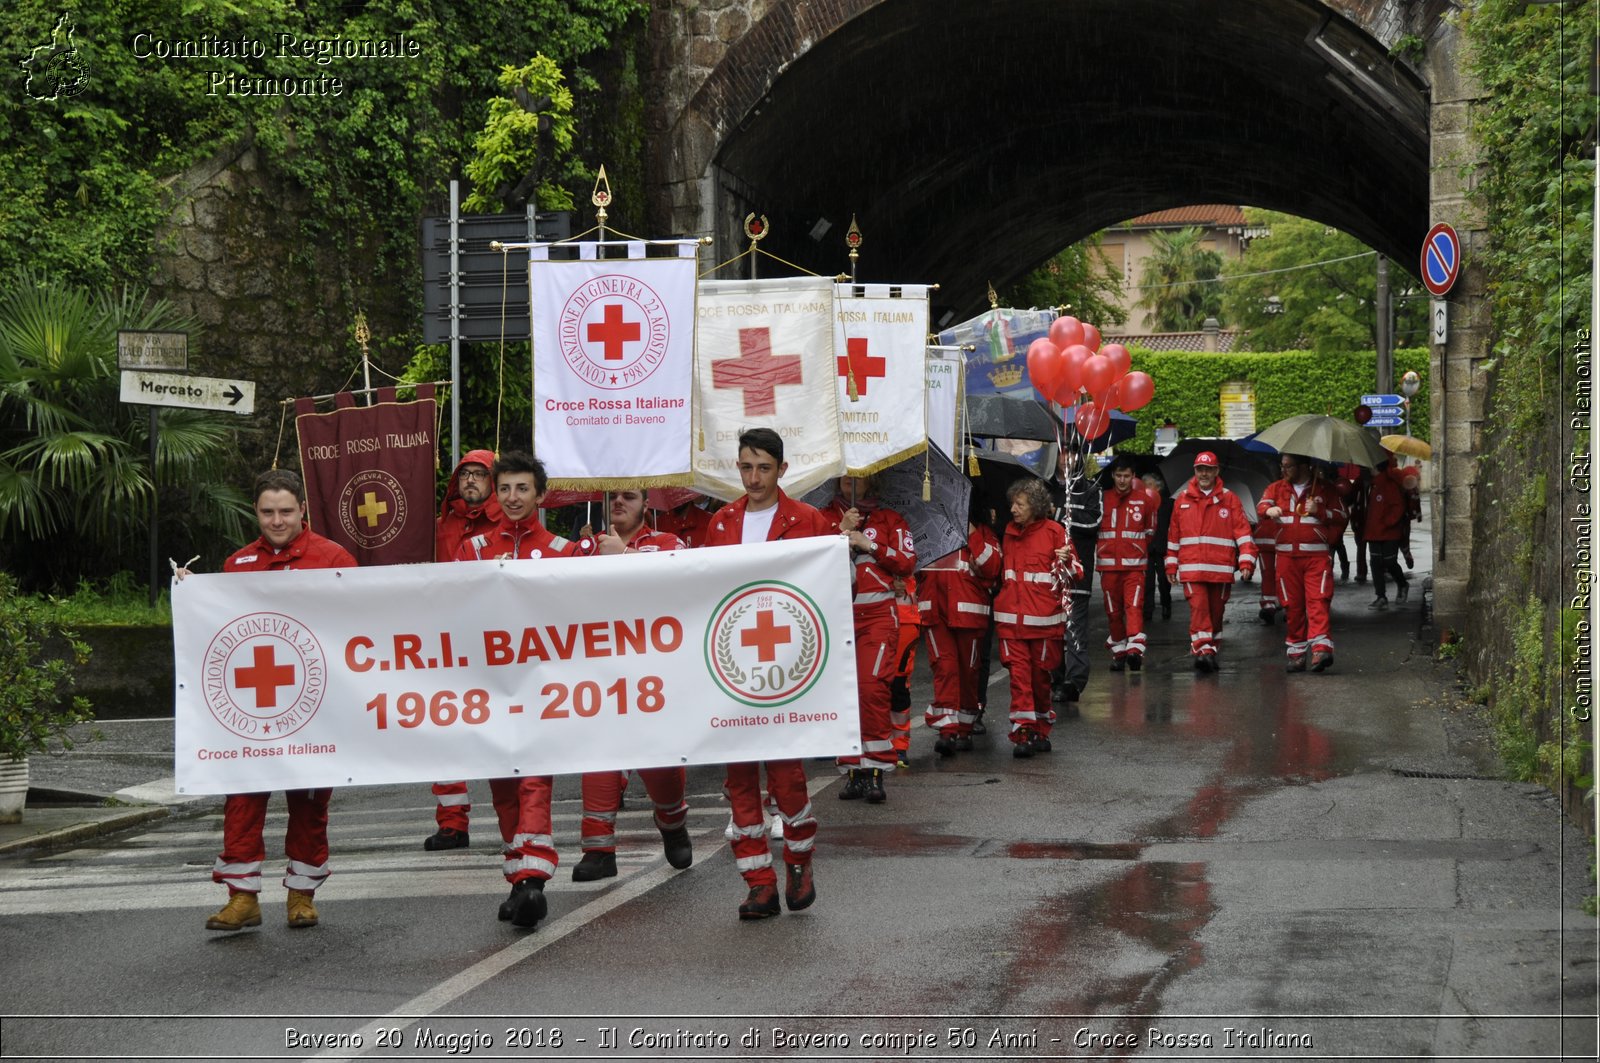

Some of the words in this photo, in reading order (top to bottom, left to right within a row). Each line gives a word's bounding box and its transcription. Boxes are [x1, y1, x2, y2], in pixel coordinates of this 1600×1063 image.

[573, 291, 589, 308] DI
[588, 278, 642, 301] GINEVRA
[643, 298, 659, 314] 22
[699, 307, 723, 319] OCE
[727, 304, 769, 316] ROSSA
[773, 302, 827, 314] ITALIANA
[837, 311, 867, 323] ROSSA
[873, 311, 914, 323] ITALIANA
[563, 308, 606, 385] CONVENZIONE
[645, 316, 666, 365] AGOSTO
[623, 362, 648, 383] 1864
[141, 381, 203, 397] Mercato
[545, 398, 585, 411] Croce
[588, 397, 631, 410] Rossa
[636, 396, 685, 409] Italiana
[566, 415, 610, 426] Comitato
[612, 414, 622, 425] di
[625, 414, 666, 425] Baveno
[307, 443, 341, 460] CROCE
[347, 437, 381, 455] ROSSA
[386, 431, 430, 449] ITALIANA
[792, 451, 829, 466] TOCE
[345, 487, 353, 496] DI
[353, 473, 382, 485] GINEVRA
[387, 479, 398, 490] 22
[394, 489, 406, 523] AGOSTO
[220, 631, 238, 649] DI
[237, 617, 300, 643] GINEVRA
[298, 638, 315, 655] 22
[344, 631, 468, 673] C.R.I.
[483, 615, 683, 666] BAVENO
[299, 657, 322, 713] AGOSTO
[750, 664, 785, 692] 50
[208, 647, 257, 734] CONVENZIONE
[366, 688, 491, 730] 1968
[508, 704, 524, 714] -
[540, 675, 666, 720] 2018
[275, 709, 303, 733] 1864
[710, 715, 769, 728] Comitato
[773, 713, 785, 724] di
[789, 711, 838, 723] Baveno
[197, 748, 238, 761] Croce
[242, 746, 283, 758] Rossa
[288, 743, 336, 755] Italiana
